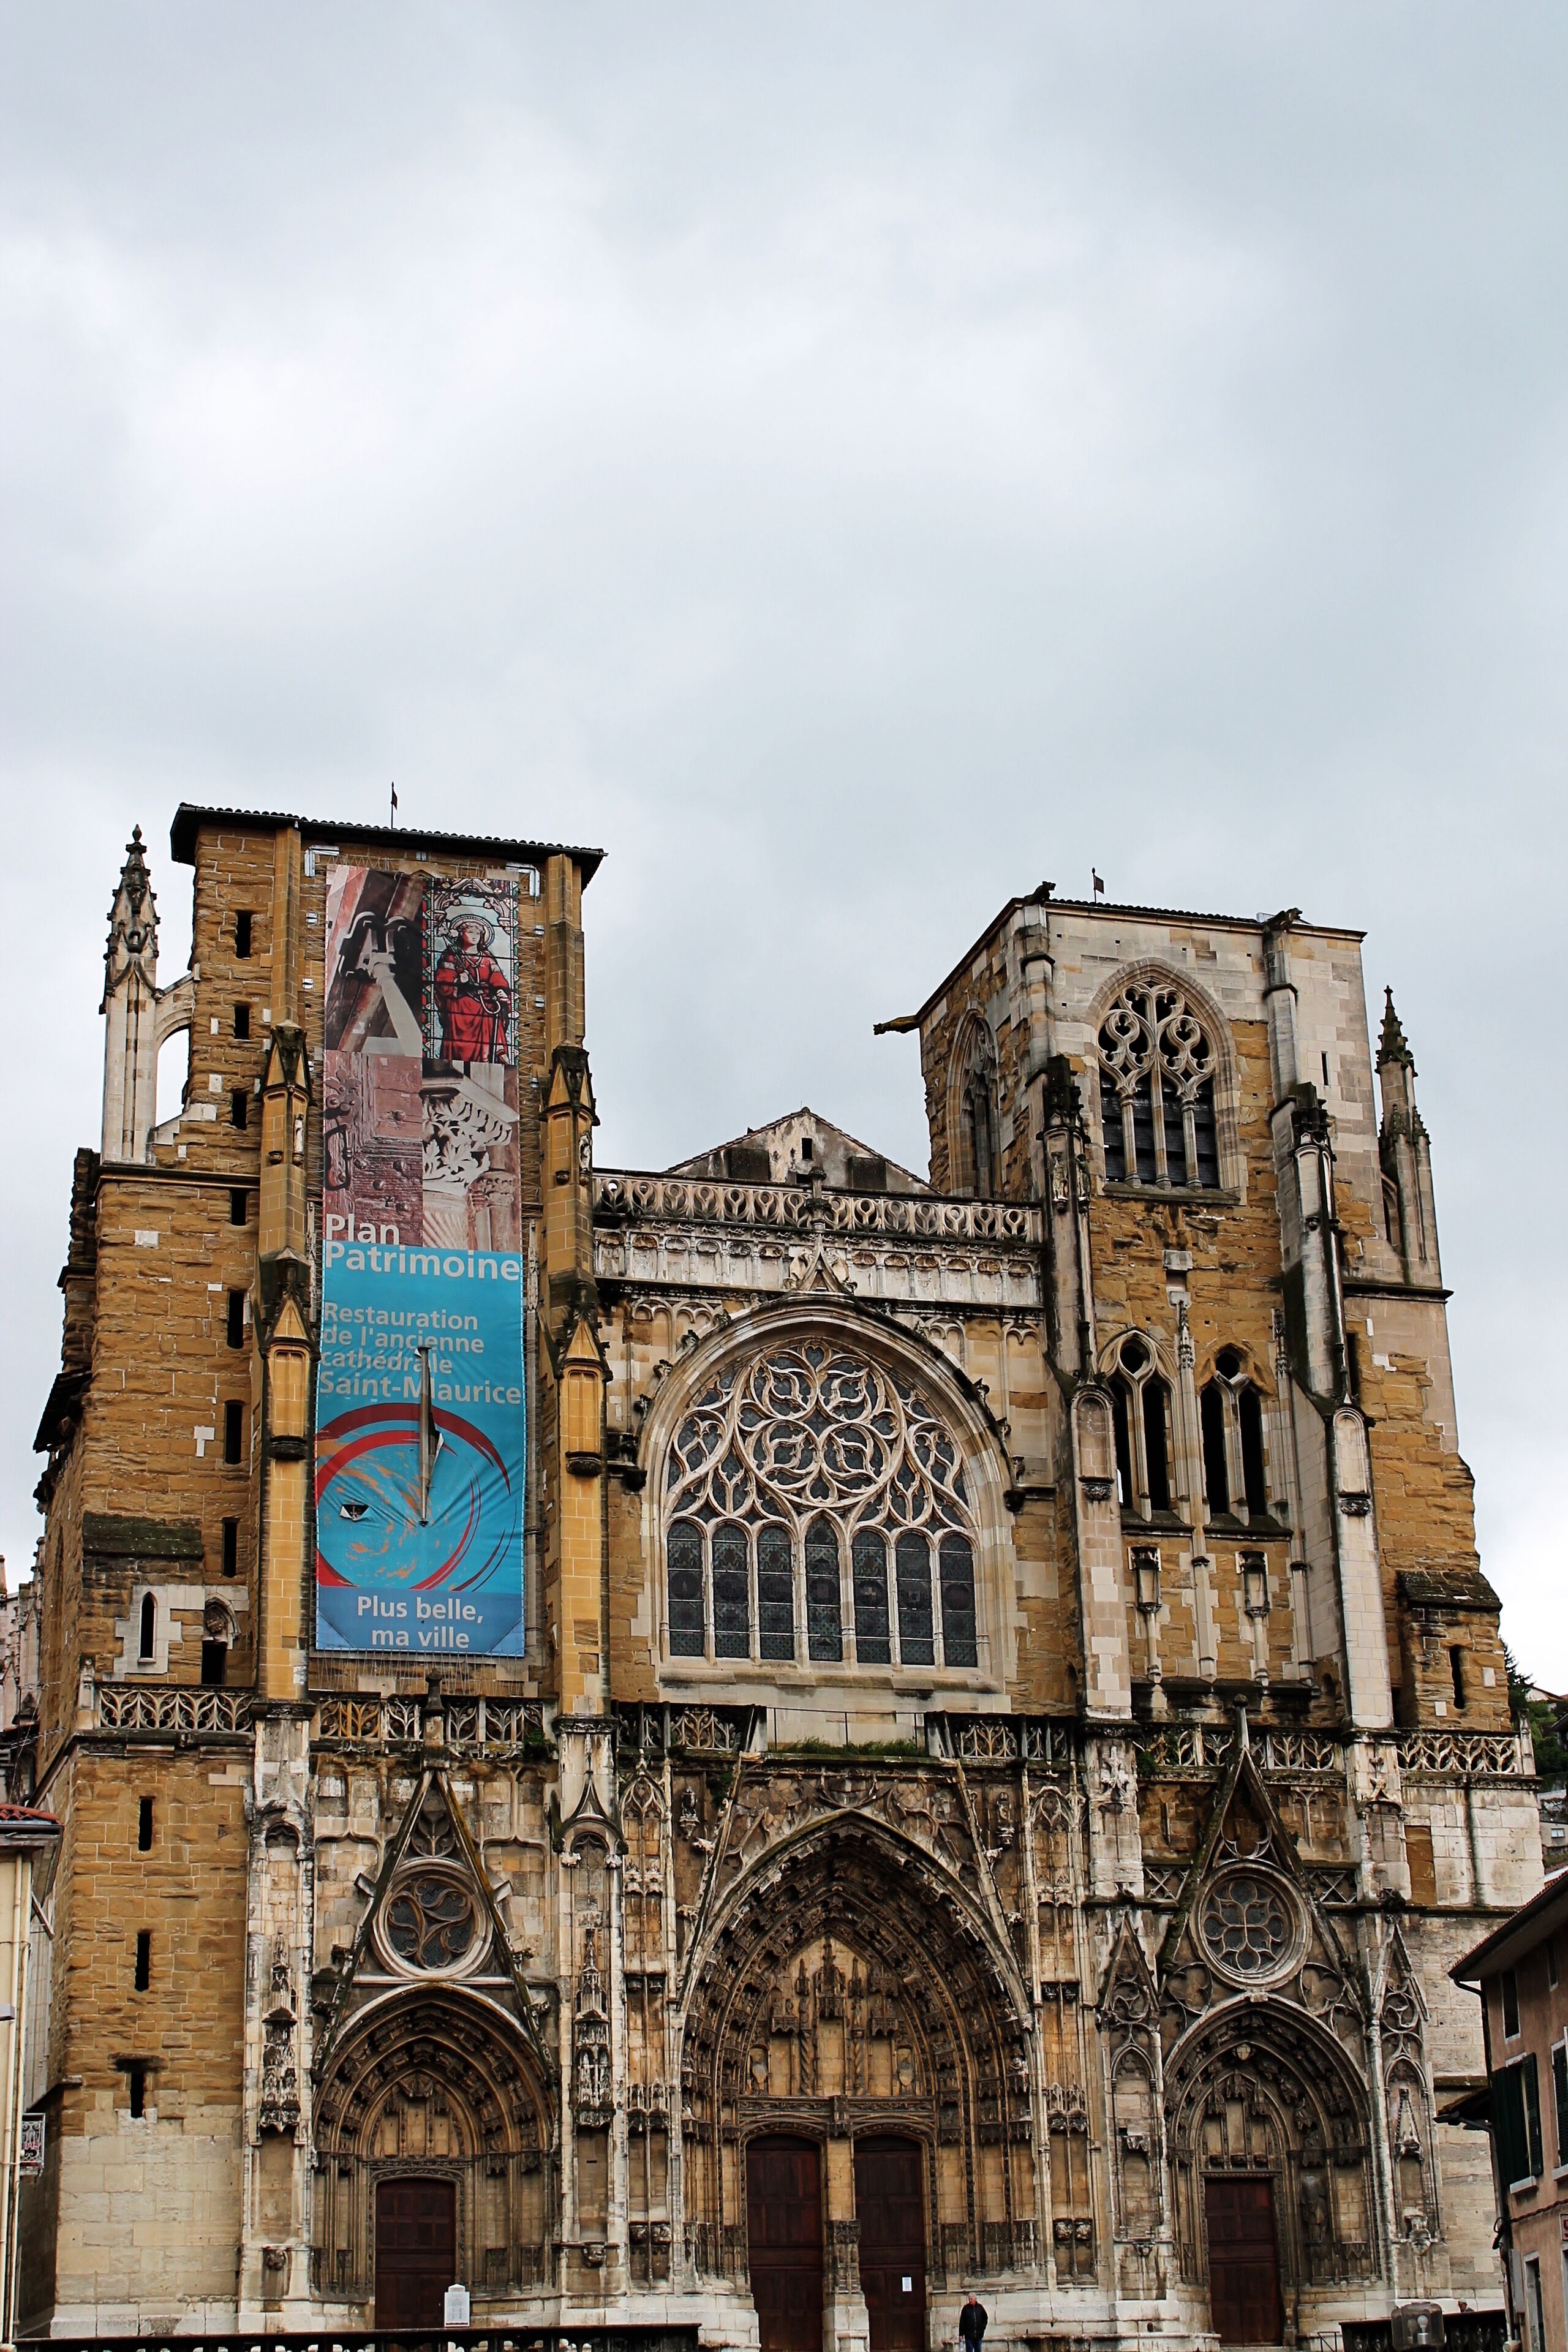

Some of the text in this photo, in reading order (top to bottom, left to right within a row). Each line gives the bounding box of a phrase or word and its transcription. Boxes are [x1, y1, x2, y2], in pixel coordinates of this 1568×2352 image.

[326, 1213, 399, 1245] Plan
[326, 1242, 519, 1281] Patrimoine
[324, 1302, 478, 1330] Restauration
[323, 1324, 484, 1353] de l'ancienne
[320, 1371, 521, 1404] Saint-Maurice
[357, 1596, 483, 1623] Plus belle,
[372, 1626, 470, 1648] ma ville
